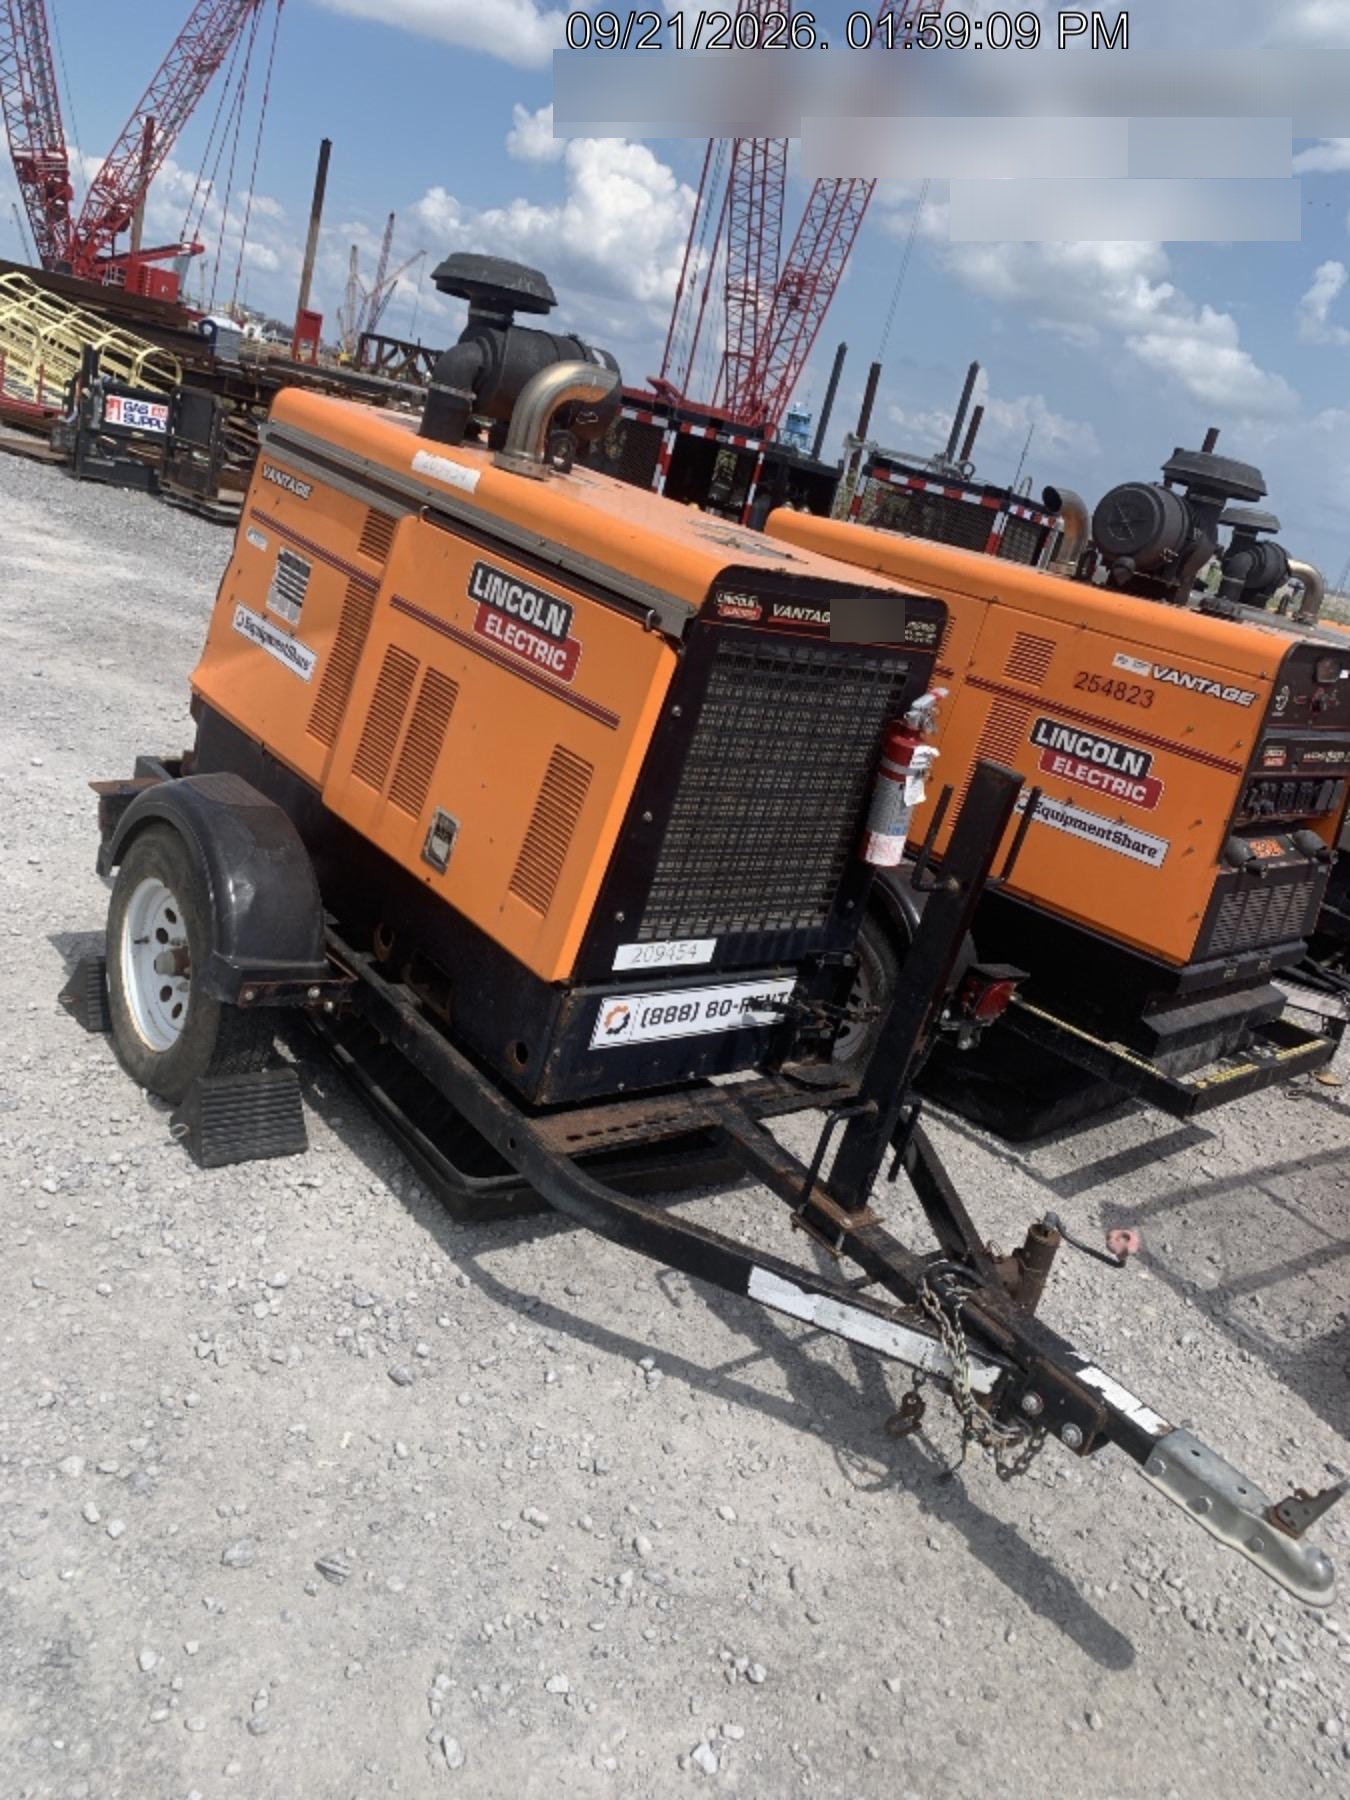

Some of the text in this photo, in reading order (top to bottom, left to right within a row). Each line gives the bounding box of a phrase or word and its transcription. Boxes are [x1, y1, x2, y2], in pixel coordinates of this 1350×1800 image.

[263, 463, 312, 500] VANTAGE
[473, 567, 567, 637] LINCOLN
[773, 603, 831, 624] VANTAG
[484, 613, 567, 671] ELECTRIC
[1073, 671, 1155, 709] 254823
[1152, 664, 1256, 708] VANTAGE
[1035, 722, 1145, 777] LINCOLN
[1051, 755, 1147, 801] ELECTRIC
[632, 942, 697, 964] 209454
[640, 1003, 700, 1028] (888)
